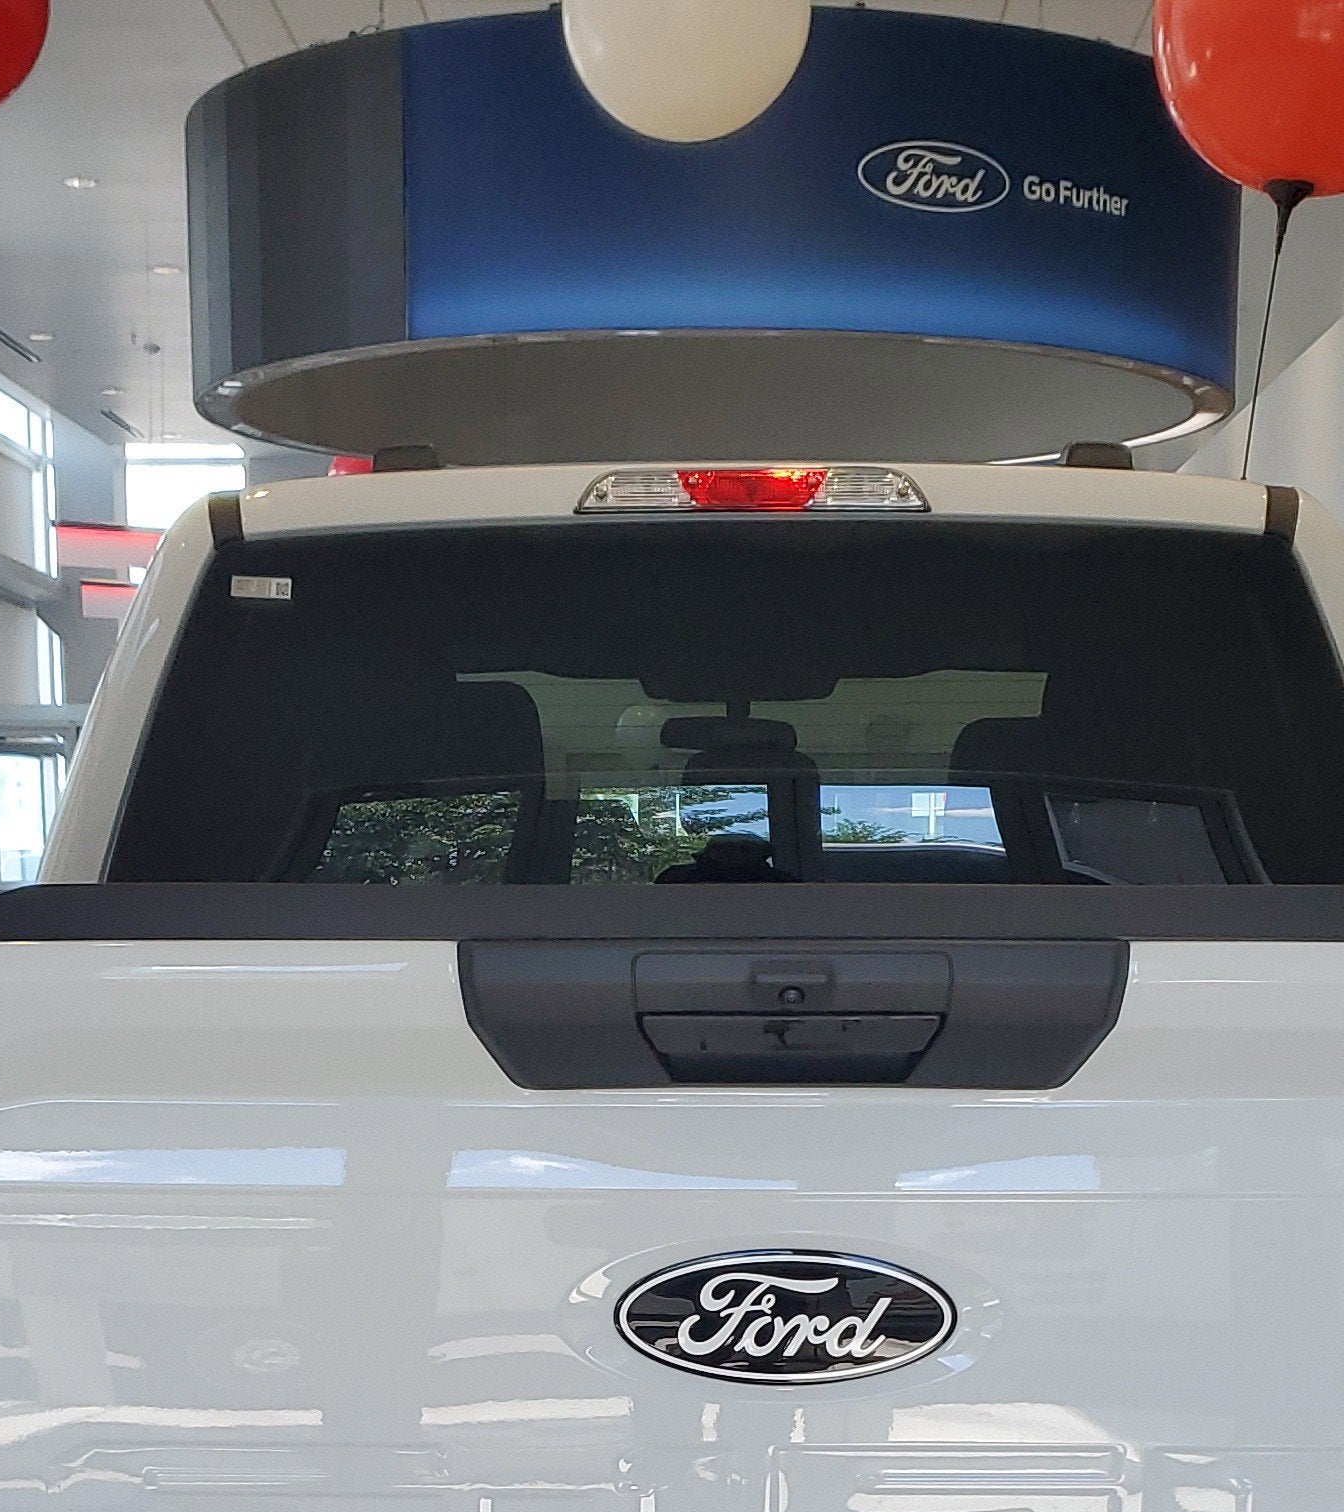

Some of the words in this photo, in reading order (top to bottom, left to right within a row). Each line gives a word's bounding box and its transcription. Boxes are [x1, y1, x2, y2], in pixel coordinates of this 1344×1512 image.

[885, 148, 987, 203] Ford
[1022, 175, 1056, 203] Go
[1058, 180, 1129, 217] Further
[677, 1272, 892, 1358] Ford
